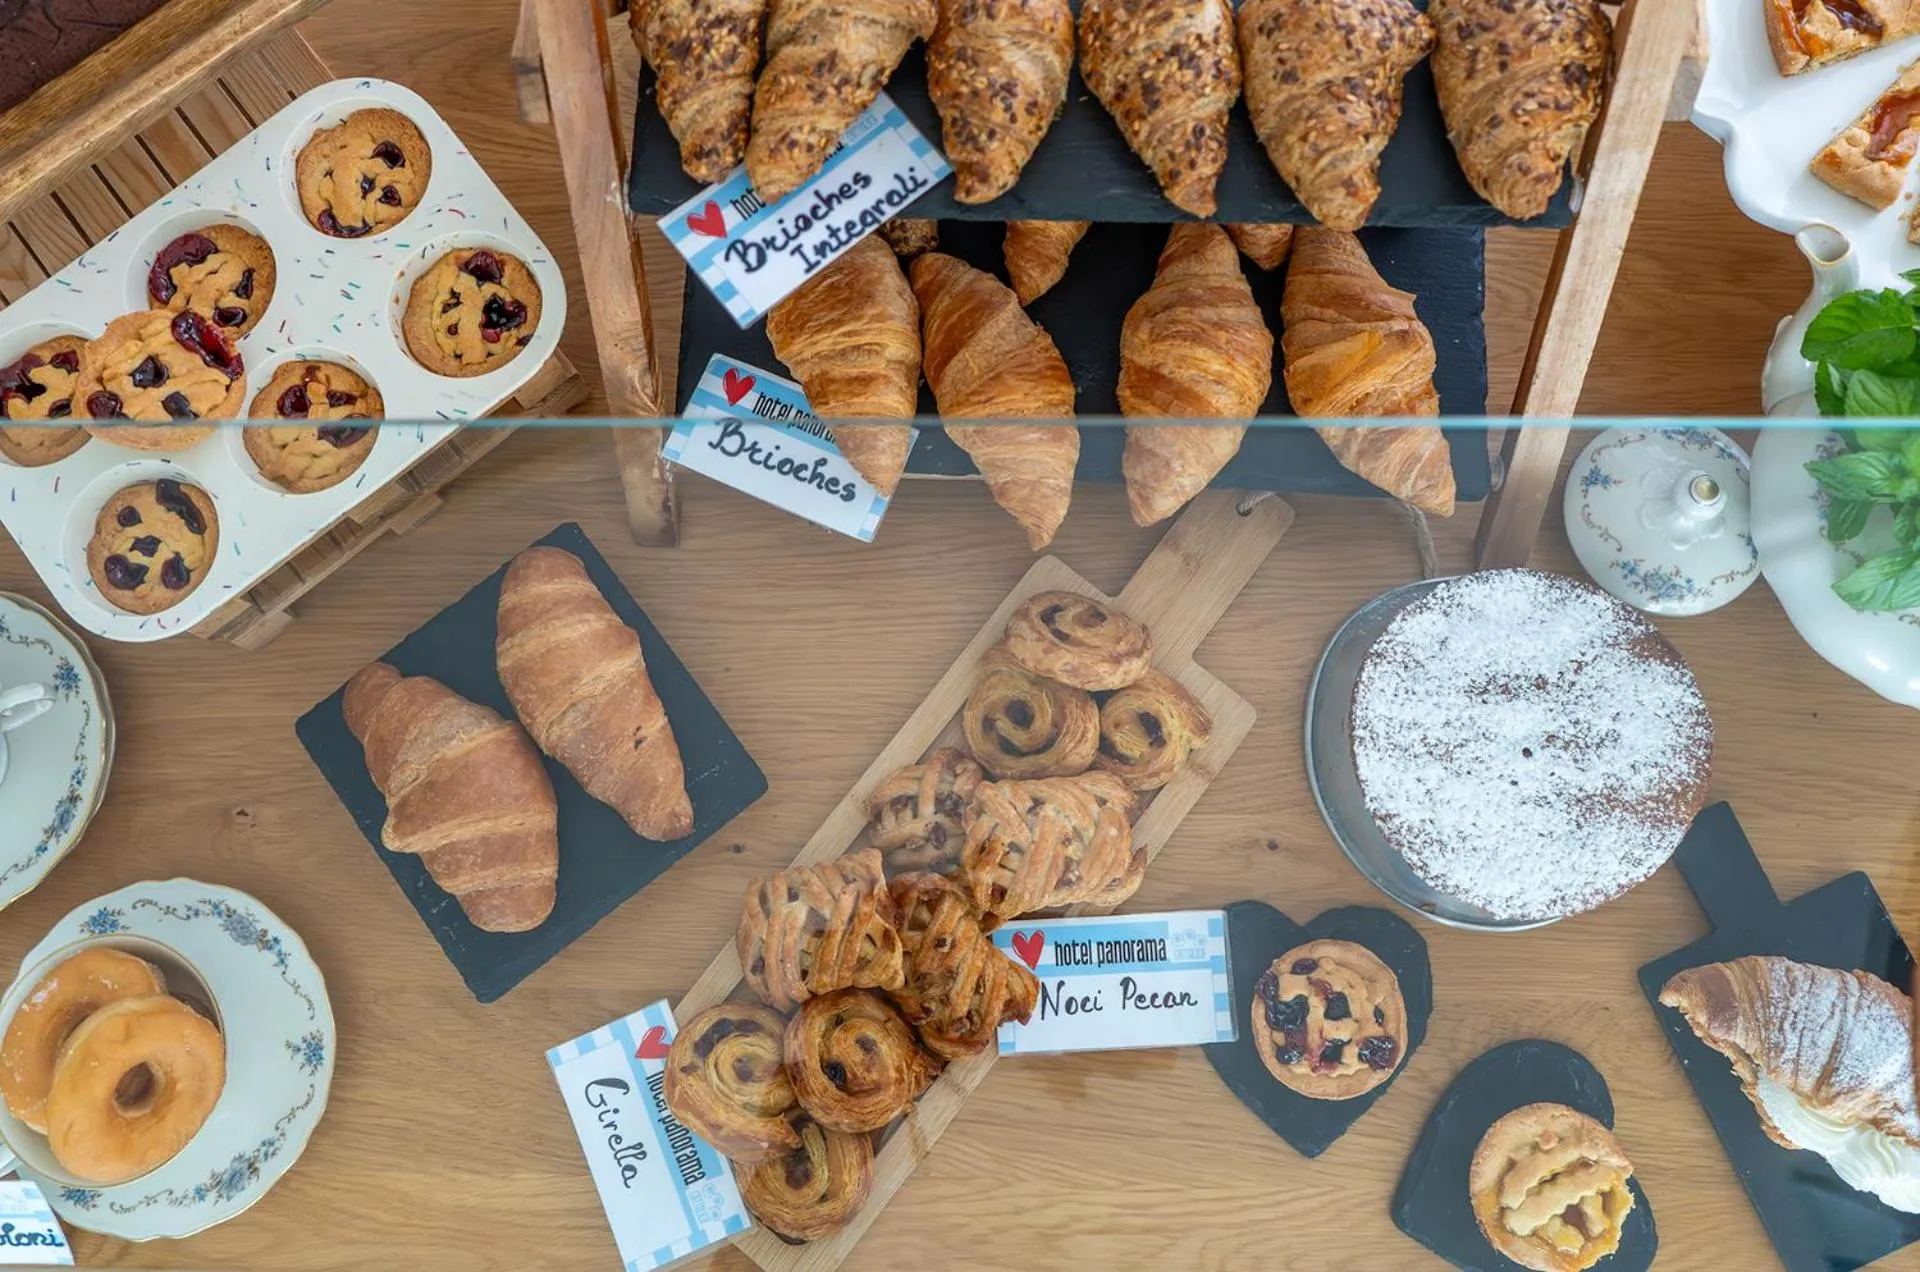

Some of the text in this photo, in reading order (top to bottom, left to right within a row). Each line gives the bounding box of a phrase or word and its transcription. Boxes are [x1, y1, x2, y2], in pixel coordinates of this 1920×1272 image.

[724, 169, 872, 274] Brioches
[730, 187, 767, 221] hot
[752, 391, 837, 443] hotel panora
[708, 417, 857, 502] Brioches
[1054, 940, 1093, 967] hotel
[1096, 937, 1168, 968] panorama
[1040, 976, 1198, 1021] Noci Pecan
[584, 1077, 648, 1189] Girella
[658, 1113, 706, 1186] panorama
